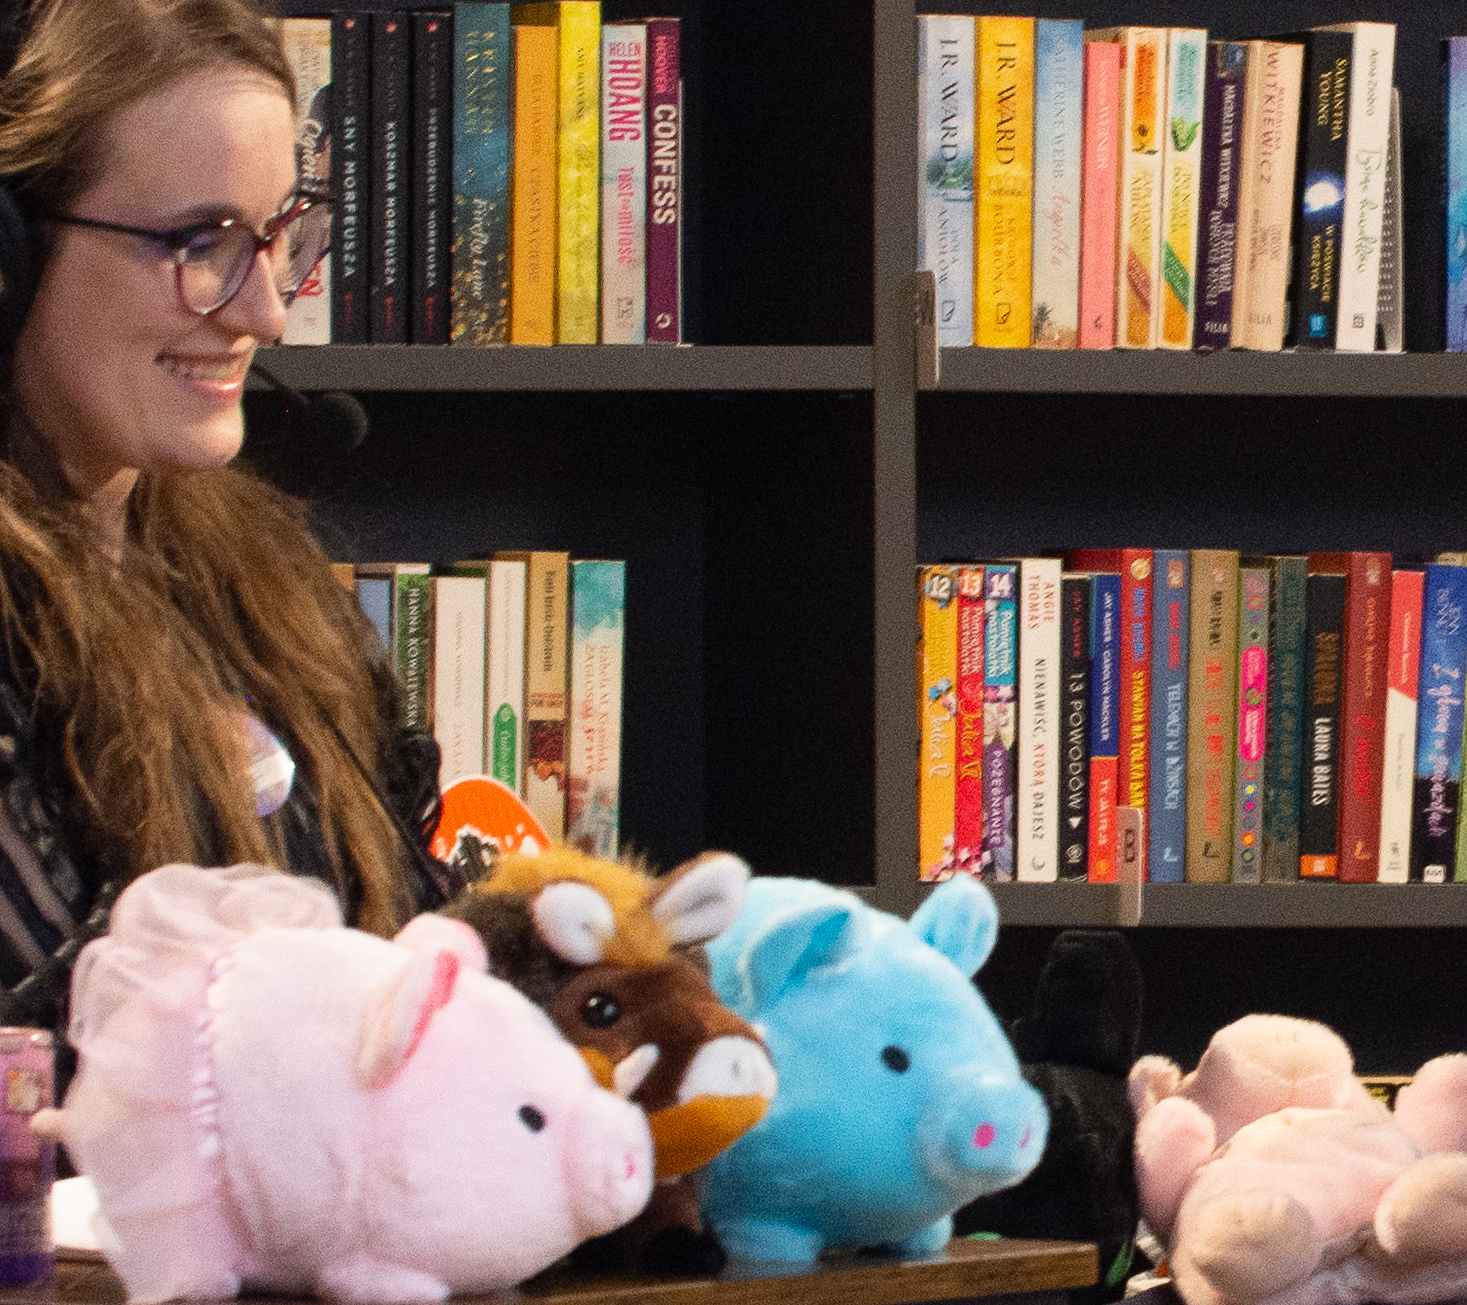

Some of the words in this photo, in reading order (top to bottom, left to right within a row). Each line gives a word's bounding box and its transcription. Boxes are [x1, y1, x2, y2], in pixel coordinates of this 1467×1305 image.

[940, 39, 958, 76] J.R.
[996, 42, 1017, 74] J.R.
[609, 59, 641, 141] HOANG
[940, 83, 959, 161] WARD
[997, 84, 1017, 165] WARD
[1259, 51, 1278, 184] WITKIEWICZ
[1316, 71, 1332, 126] YOUNG
[1329, 59, 1348, 141] SAMANTHA
[653, 104, 676, 224] CONFESS
[1069, 673, 1082, 693] 13
[1068, 700, 1085, 809] POWODÓW
[1314, 717, 1331, 760] LAURA
[1312, 765, 1330, 806] BATES
